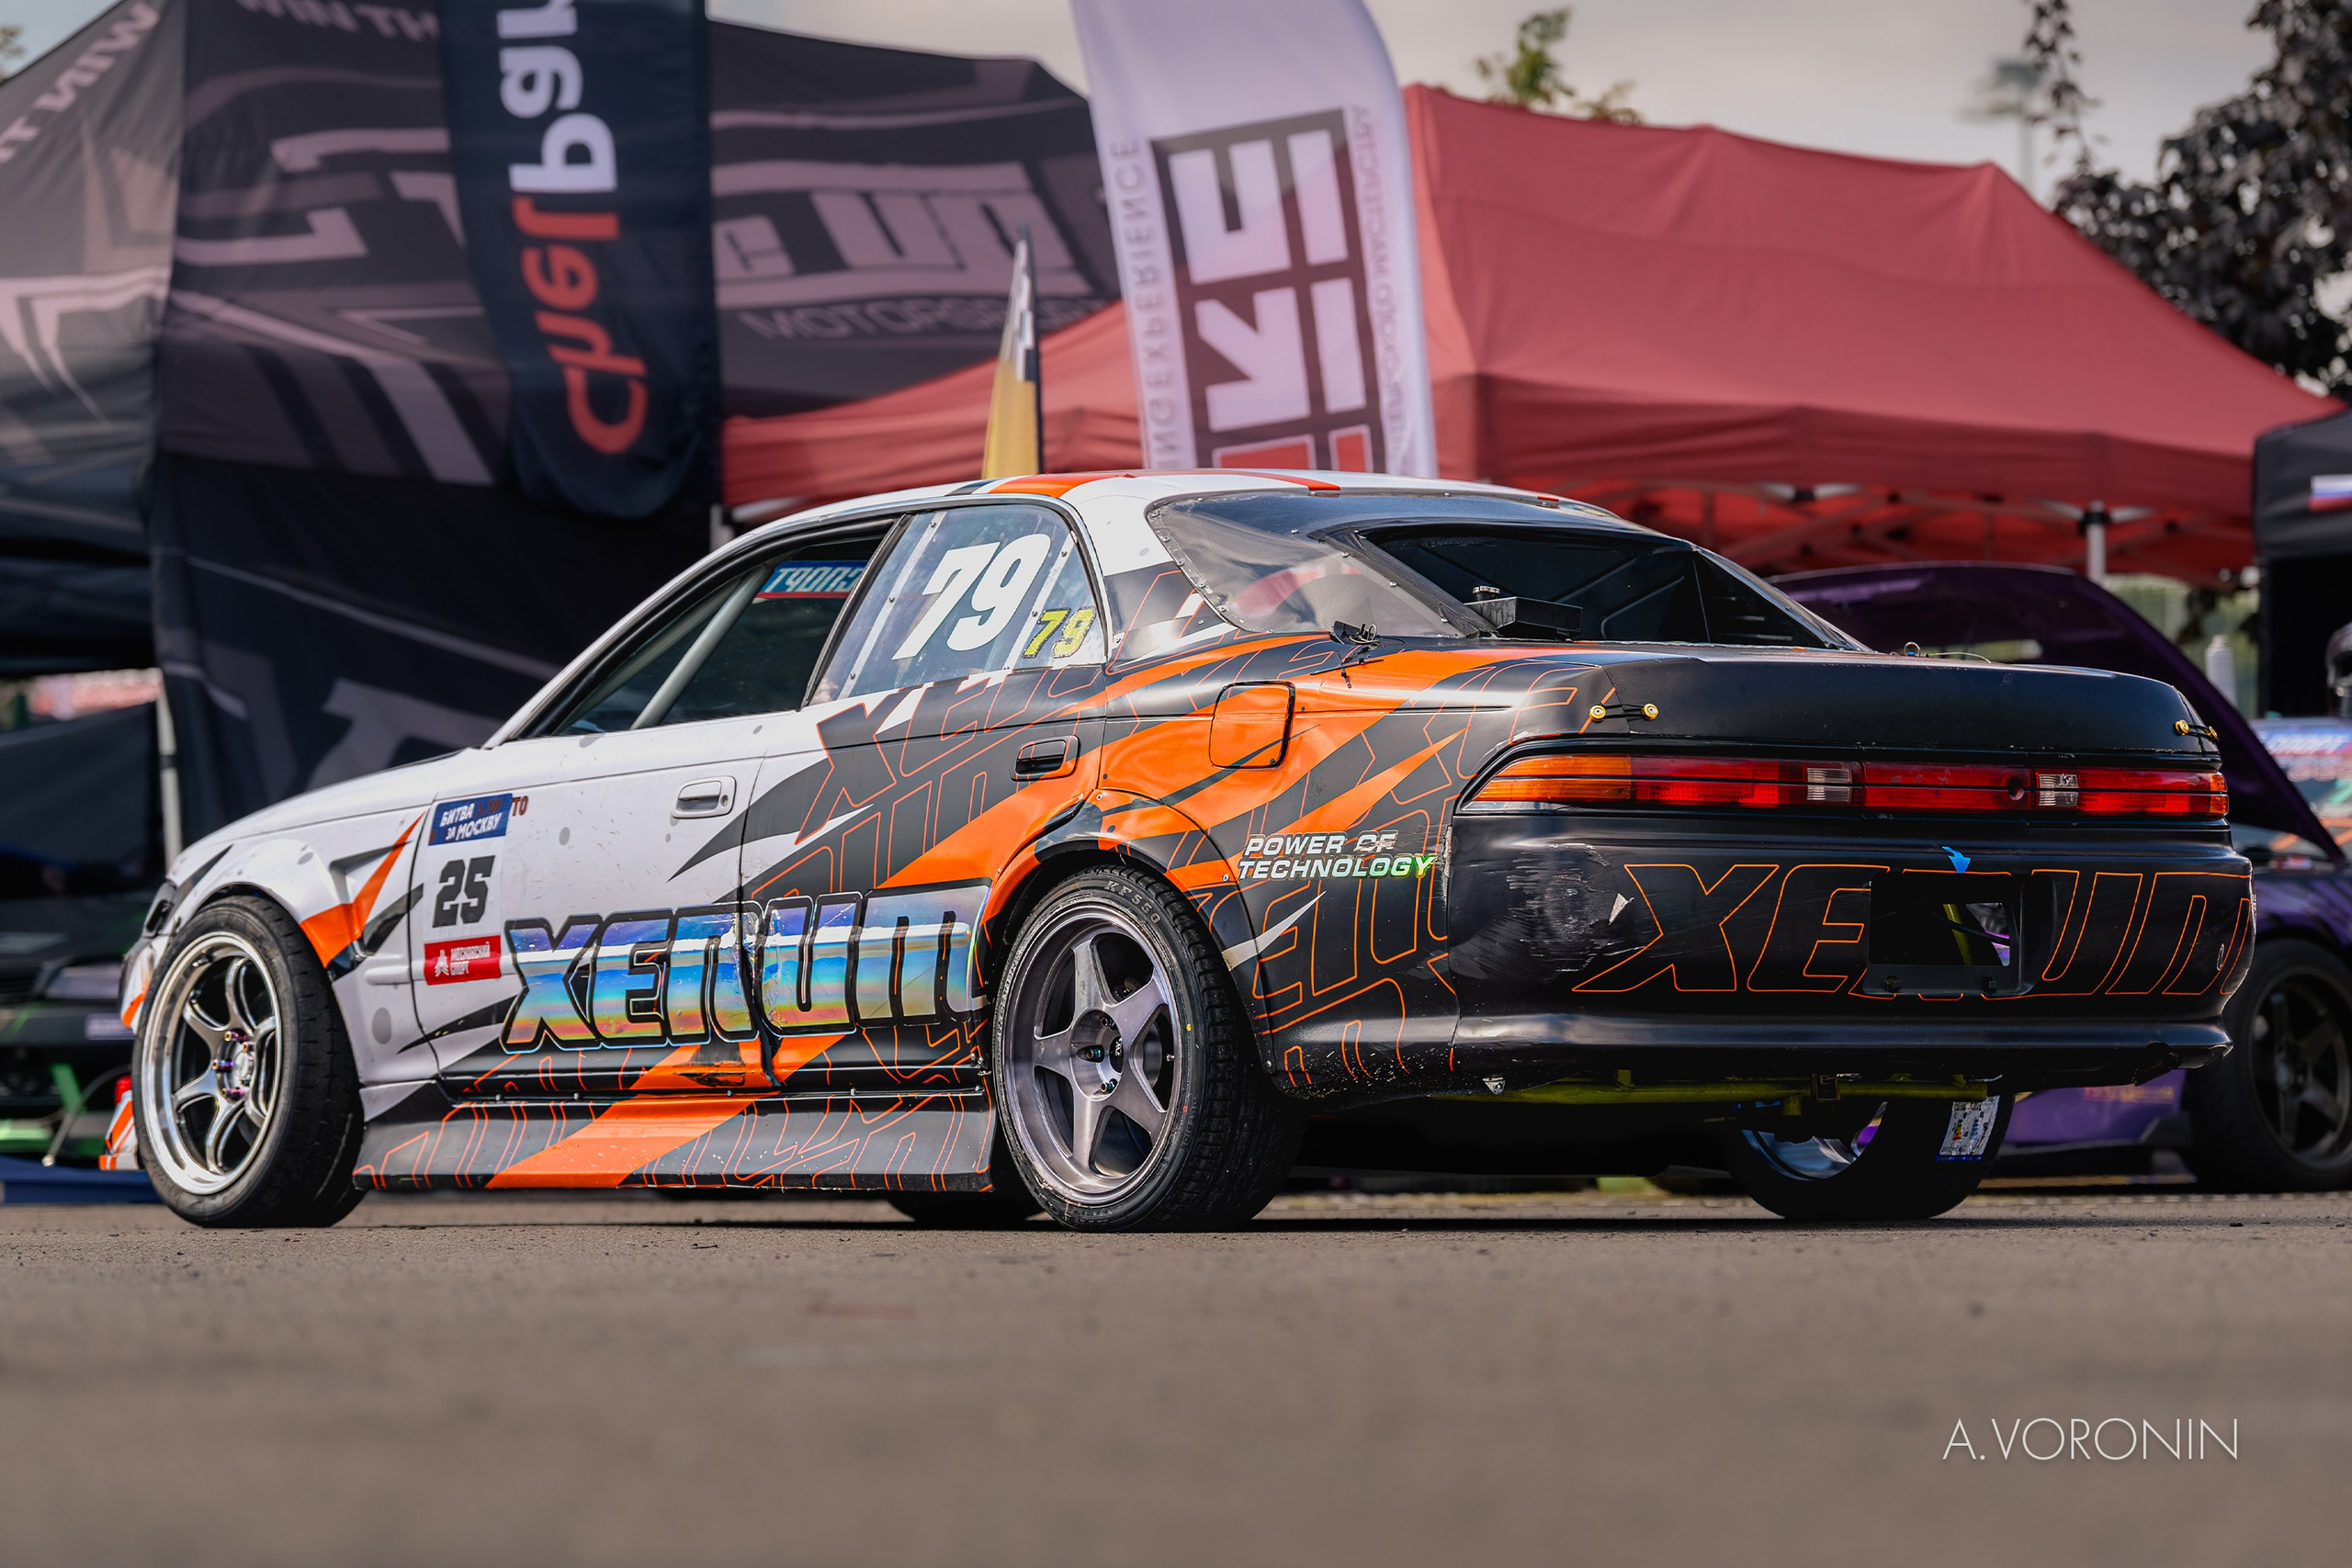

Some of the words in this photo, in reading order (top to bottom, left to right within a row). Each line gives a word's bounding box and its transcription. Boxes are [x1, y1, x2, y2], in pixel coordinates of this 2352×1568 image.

[890, 533, 1051, 661] 79
[1022, 605, 1096, 659] 79
[439, 802, 475, 828] БИТВА
[445, 827, 456, 840] ЗА
[455, 812, 503, 841] МОСКВУ
[1244, 832, 1345, 857] POWER
[1352, 830, 1397, 852] OF
[1238, 855, 1437, 880] TECHNOLOGY
[432, 854, 496, 929] 25
[1104, 880, 1161, 923] KF550
[499, 880, 990, 1054] XENUM
